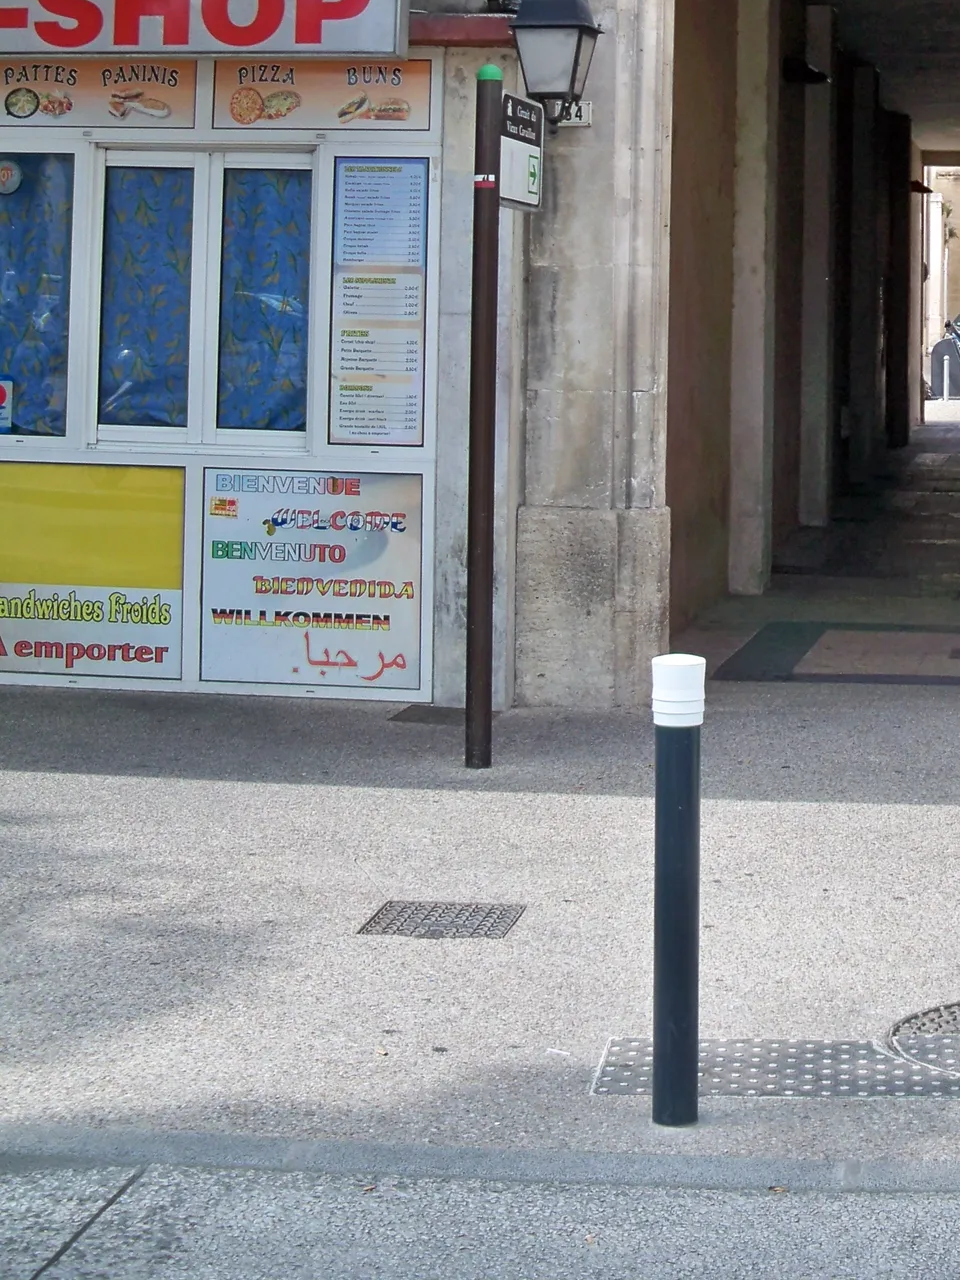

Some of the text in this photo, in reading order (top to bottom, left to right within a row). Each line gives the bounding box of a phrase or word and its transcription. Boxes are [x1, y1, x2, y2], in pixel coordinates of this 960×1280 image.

[101, 65, 180, 87] PANINIS
[238, 65, 403, 86] PIZZA BUNS
[216, 474, 361, 496] BIENVENUE
[271, 508, 407, 533] WELCOME
[212, 540, 347, 563] BENVENUTO
[253, 575, 415, 600] BIENVENIDA
[107, 591, 172, 626] Froids
[211, 608, 391, 631] WILLKOMMEN
[13, 638, 170, 669] emporter
